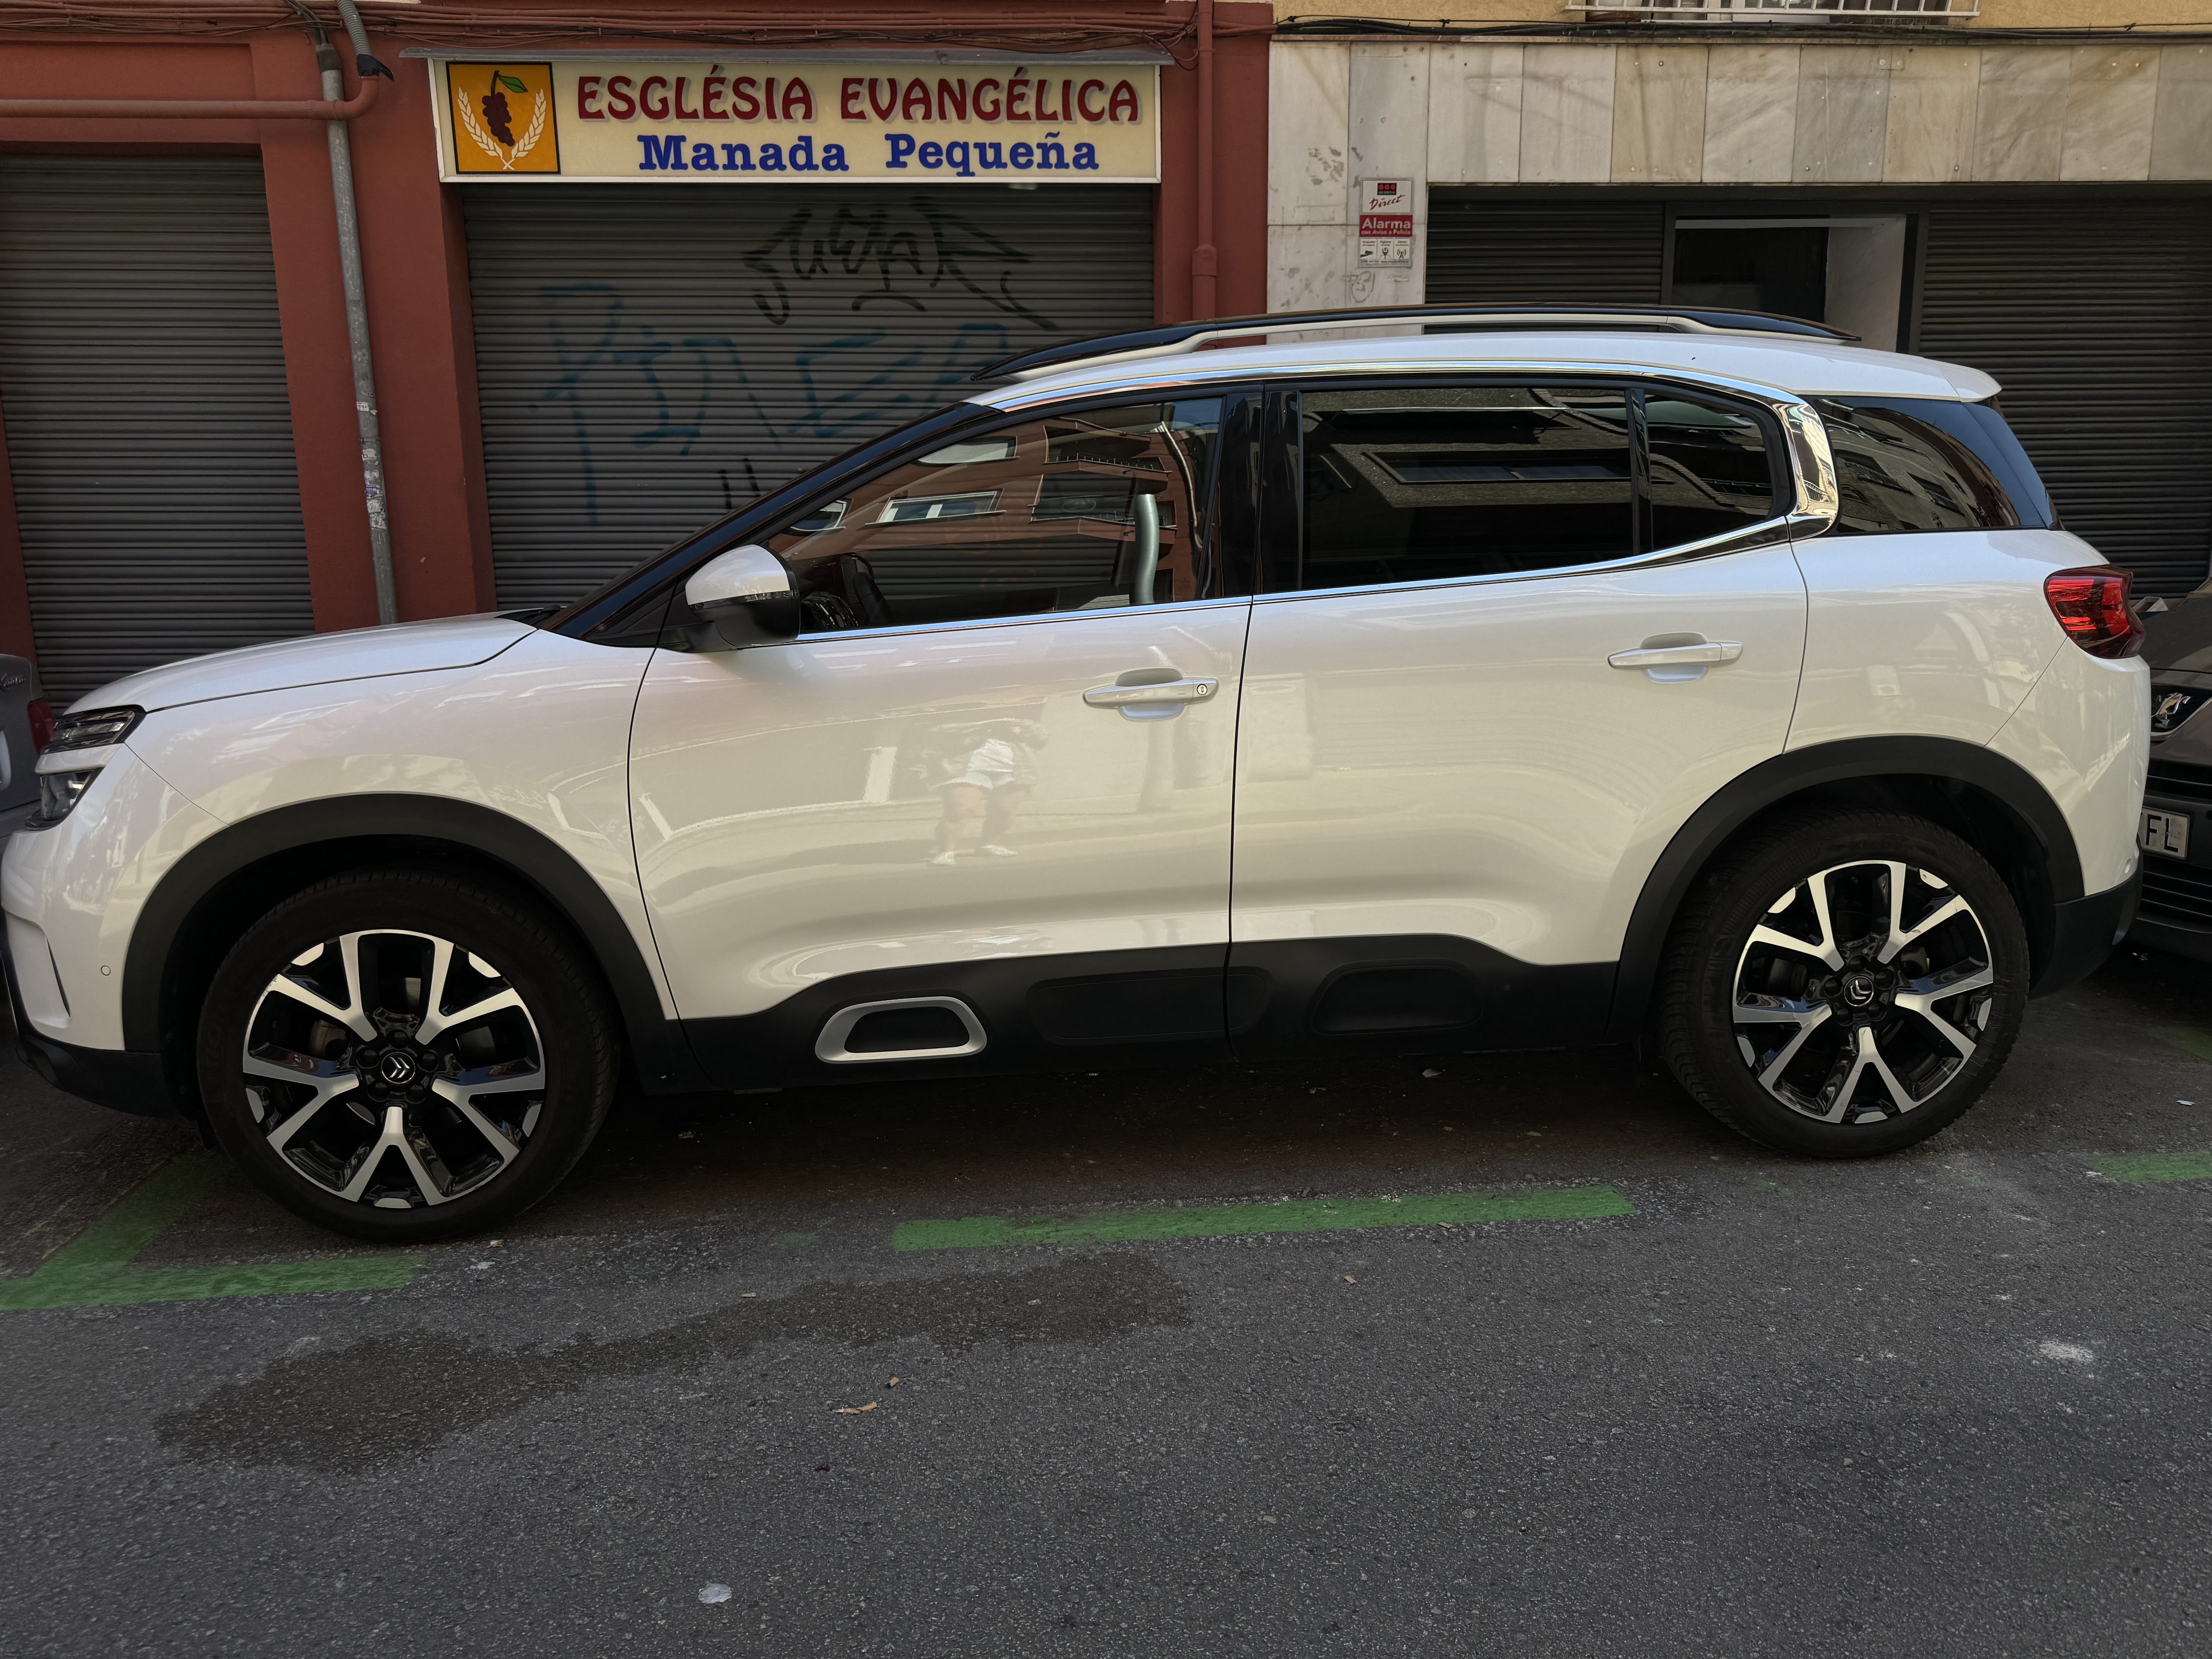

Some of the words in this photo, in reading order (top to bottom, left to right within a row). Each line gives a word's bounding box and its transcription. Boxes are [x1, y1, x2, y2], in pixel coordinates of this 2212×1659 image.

[578, 64, 813, 120] ESGLÉSIA
[840, 67, 1139, 122] EVANGÉLICA
[637, 135, 849, 171] Manada
[884, 131, 1099, 177] Pequeña
[1369, 194, 1407, 210] Direct
[1362, 217, 1411, 229] Alarma
[2142, 812, 2178, 852] FL
